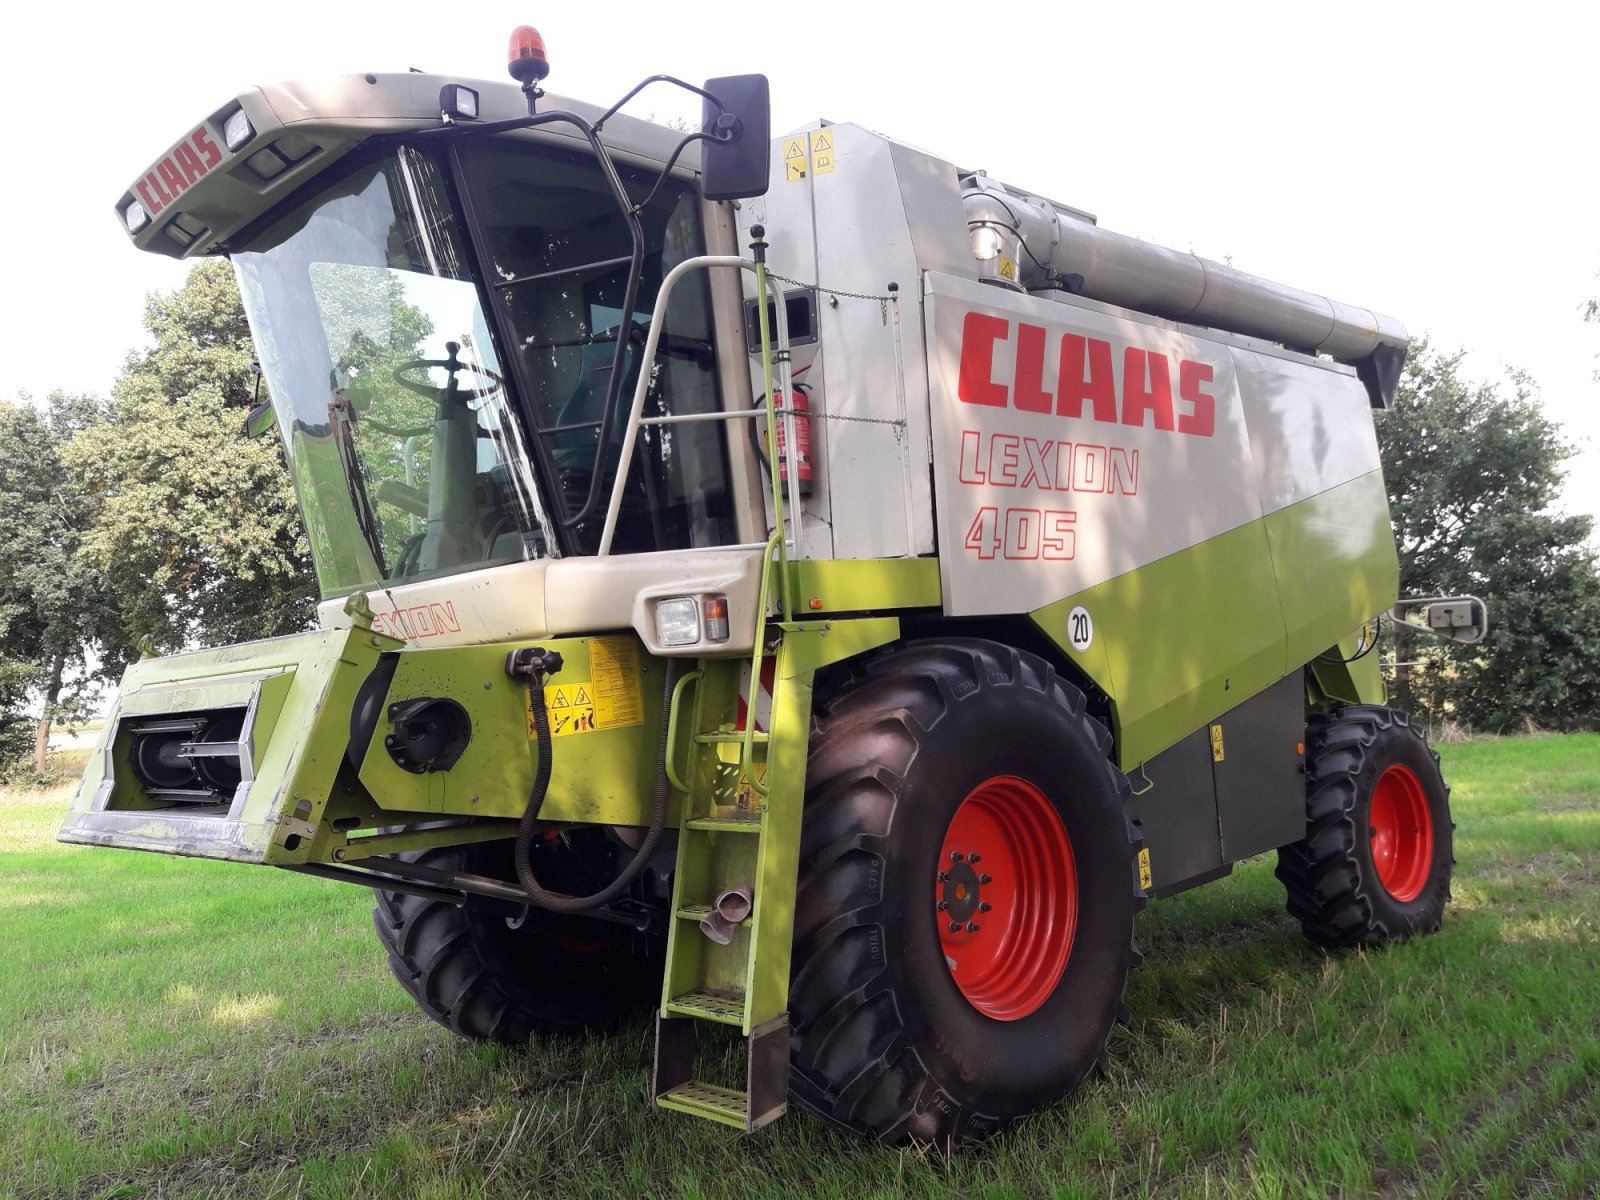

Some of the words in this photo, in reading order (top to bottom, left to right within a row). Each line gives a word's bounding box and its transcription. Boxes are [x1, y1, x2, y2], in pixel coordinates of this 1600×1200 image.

[135, 125, 223, 216] CLAAS
[958, 311, 1216, 438] CLAAS
[959, 430, 1139, 496] LEXION
[965, 506, 1077, 561] 405
[371, 600, 461, 640] EXION
[1072, 613, 1089, 643] 20
